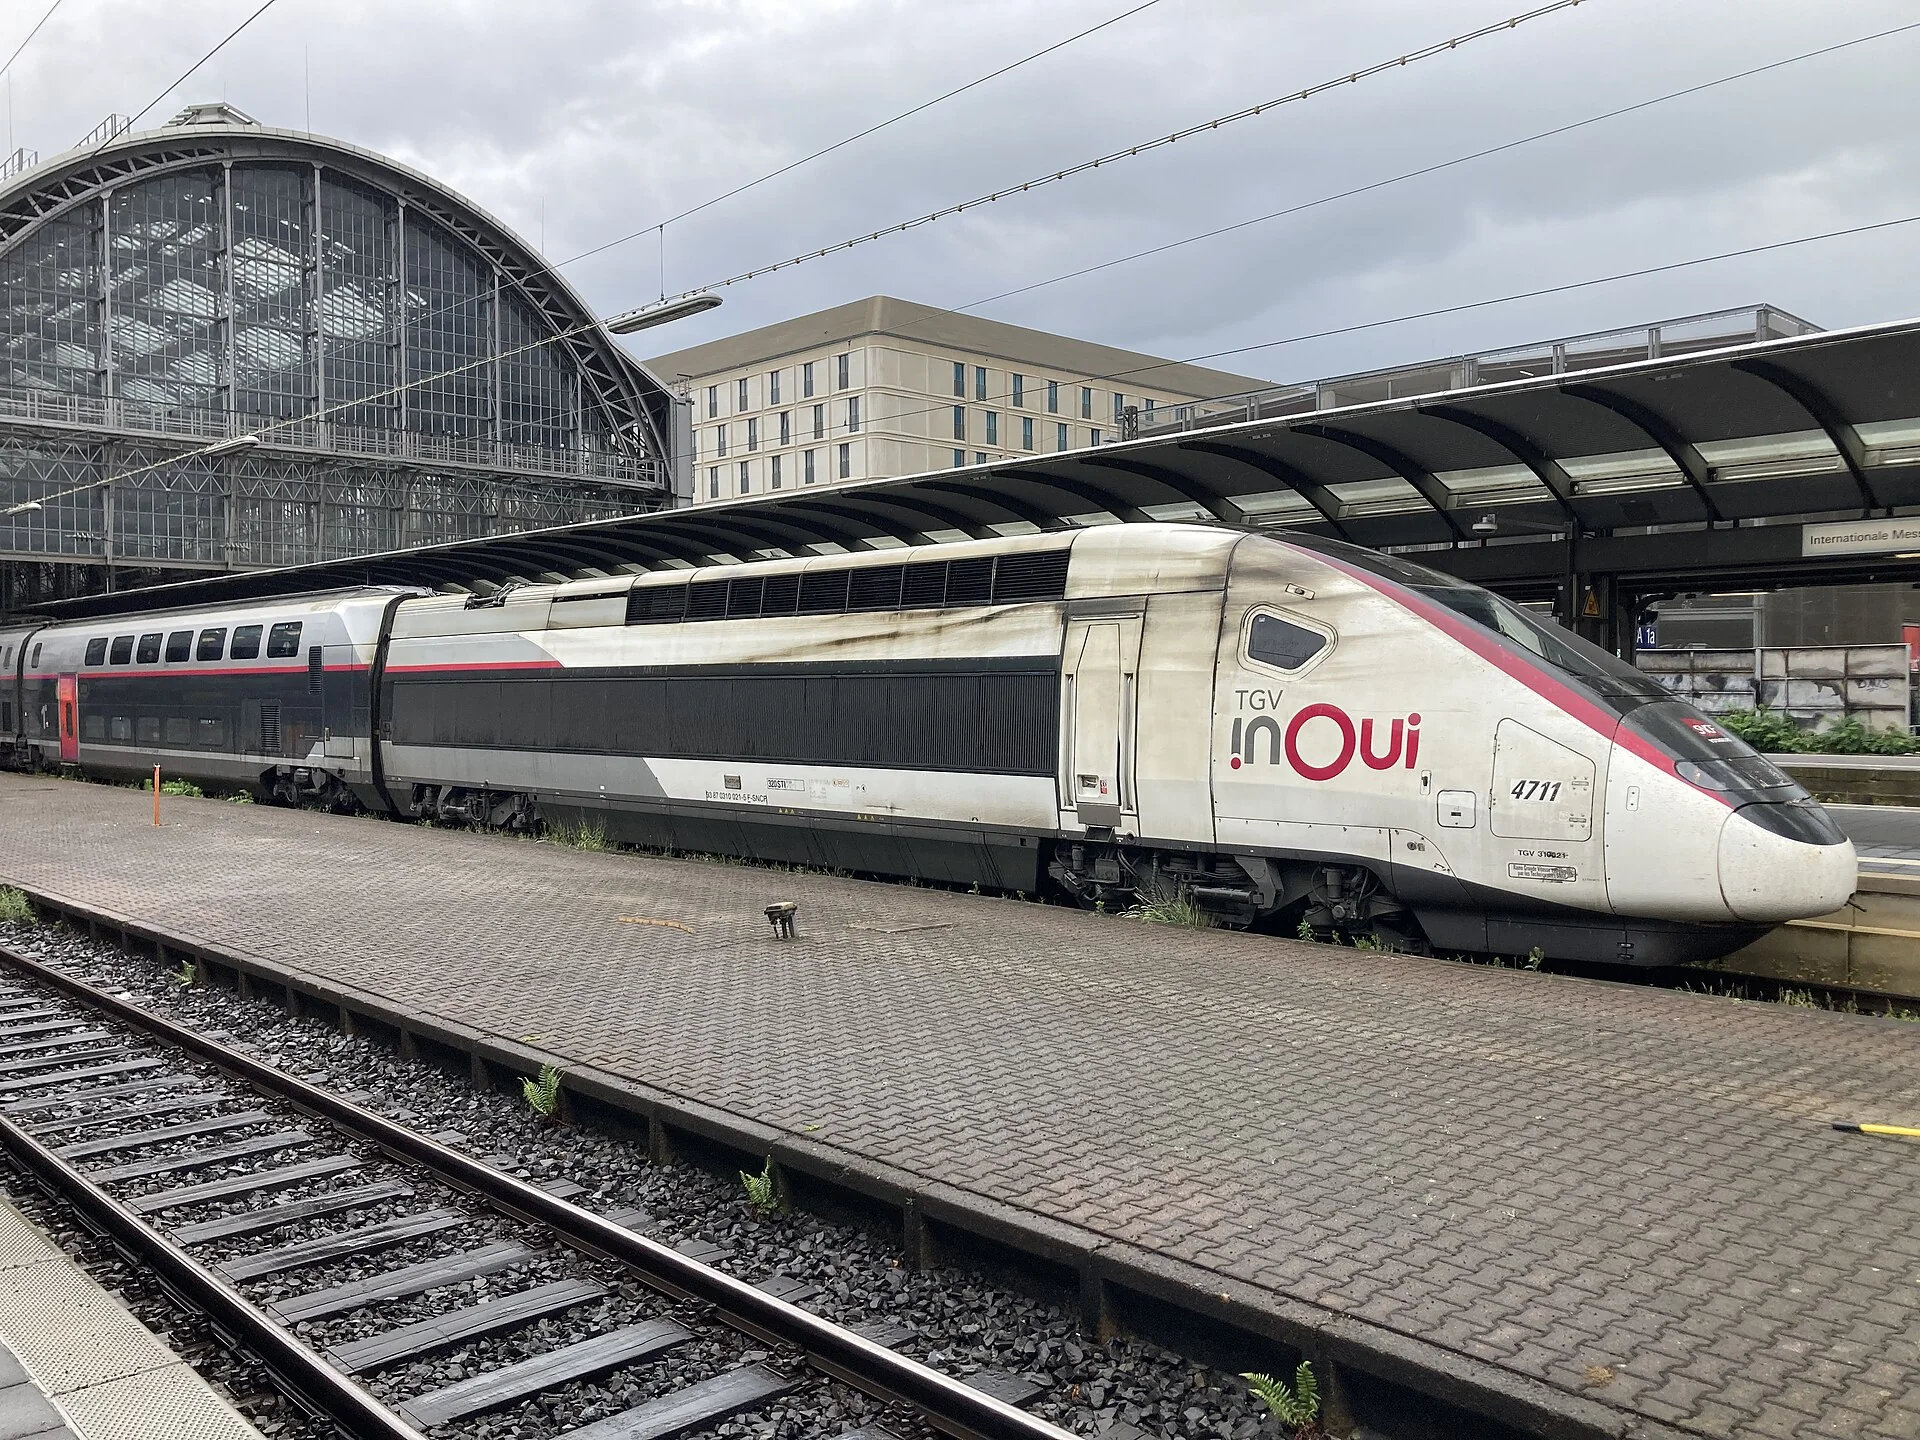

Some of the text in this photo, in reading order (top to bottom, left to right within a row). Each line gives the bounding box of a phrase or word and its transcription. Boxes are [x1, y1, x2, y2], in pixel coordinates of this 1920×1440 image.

[1810, 529, 1920, 545] Internationale Mes
[1636, 627, 1655, 644] A 1a
[1235, 690, 1283, 710] TGV
[720, 792, 731, 800] 0310
[1511, 780, 1561, 801] 4711
[1518, 849, 1535, 857] TGV
